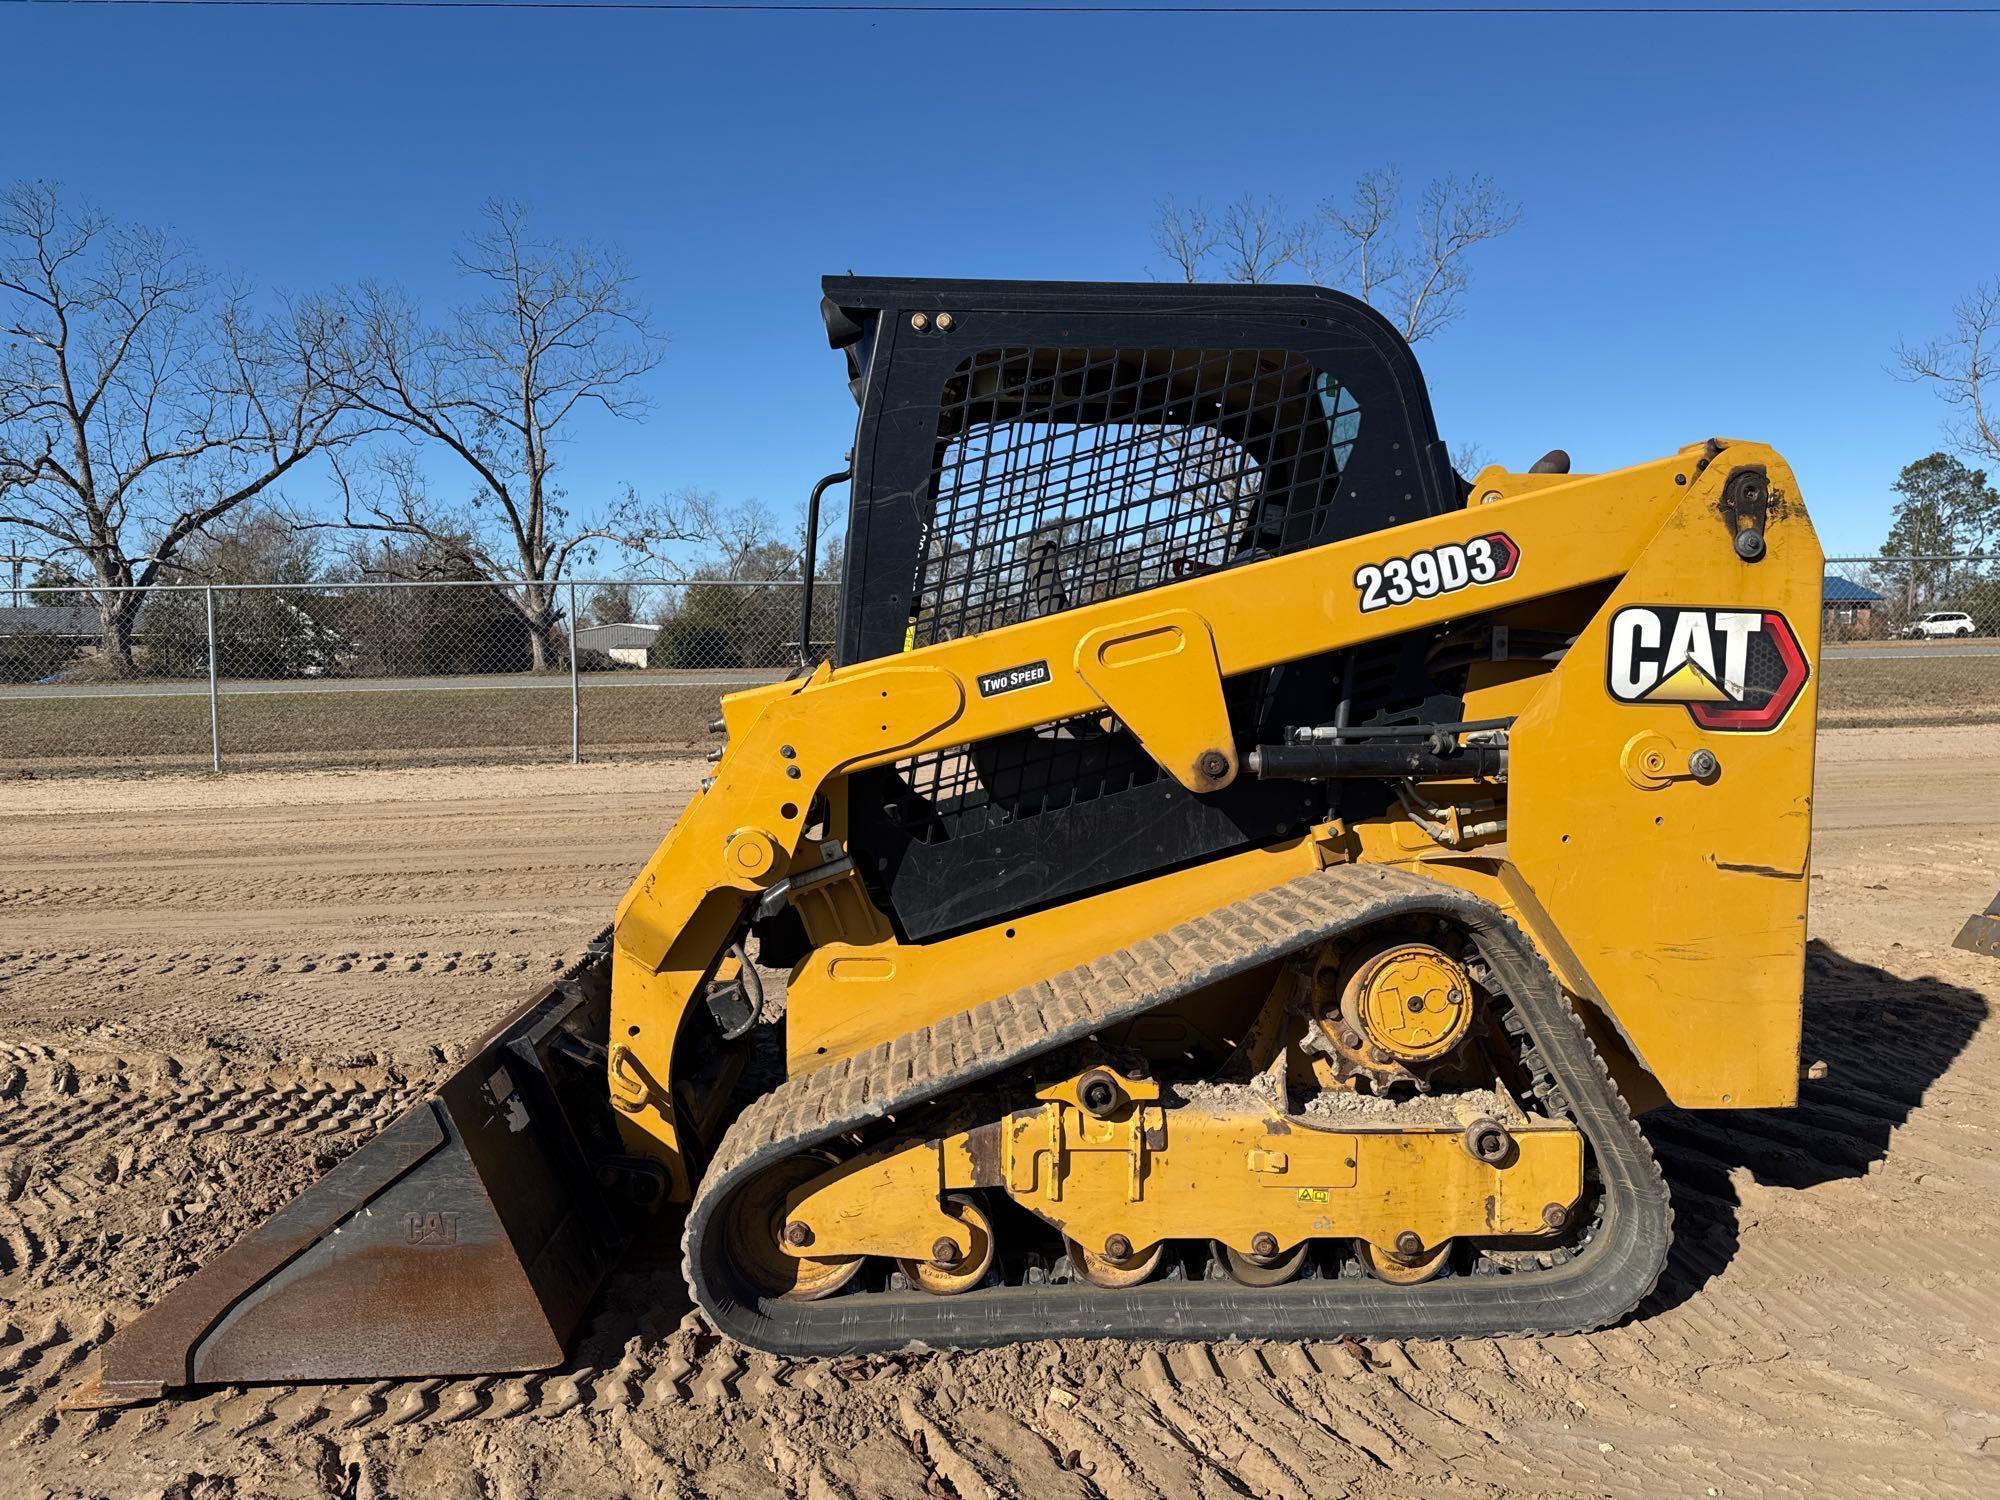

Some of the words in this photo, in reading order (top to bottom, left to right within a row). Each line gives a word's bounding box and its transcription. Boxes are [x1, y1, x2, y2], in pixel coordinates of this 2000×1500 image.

[1356, 538, 1497, 611] 239D3
[982, 677, 1008, 692] TWO
[1010, 667, 1045, 685] SPEED
[1610, 608, 1763, 702] CAT
[403, 1211, 463, 1246] CAT
